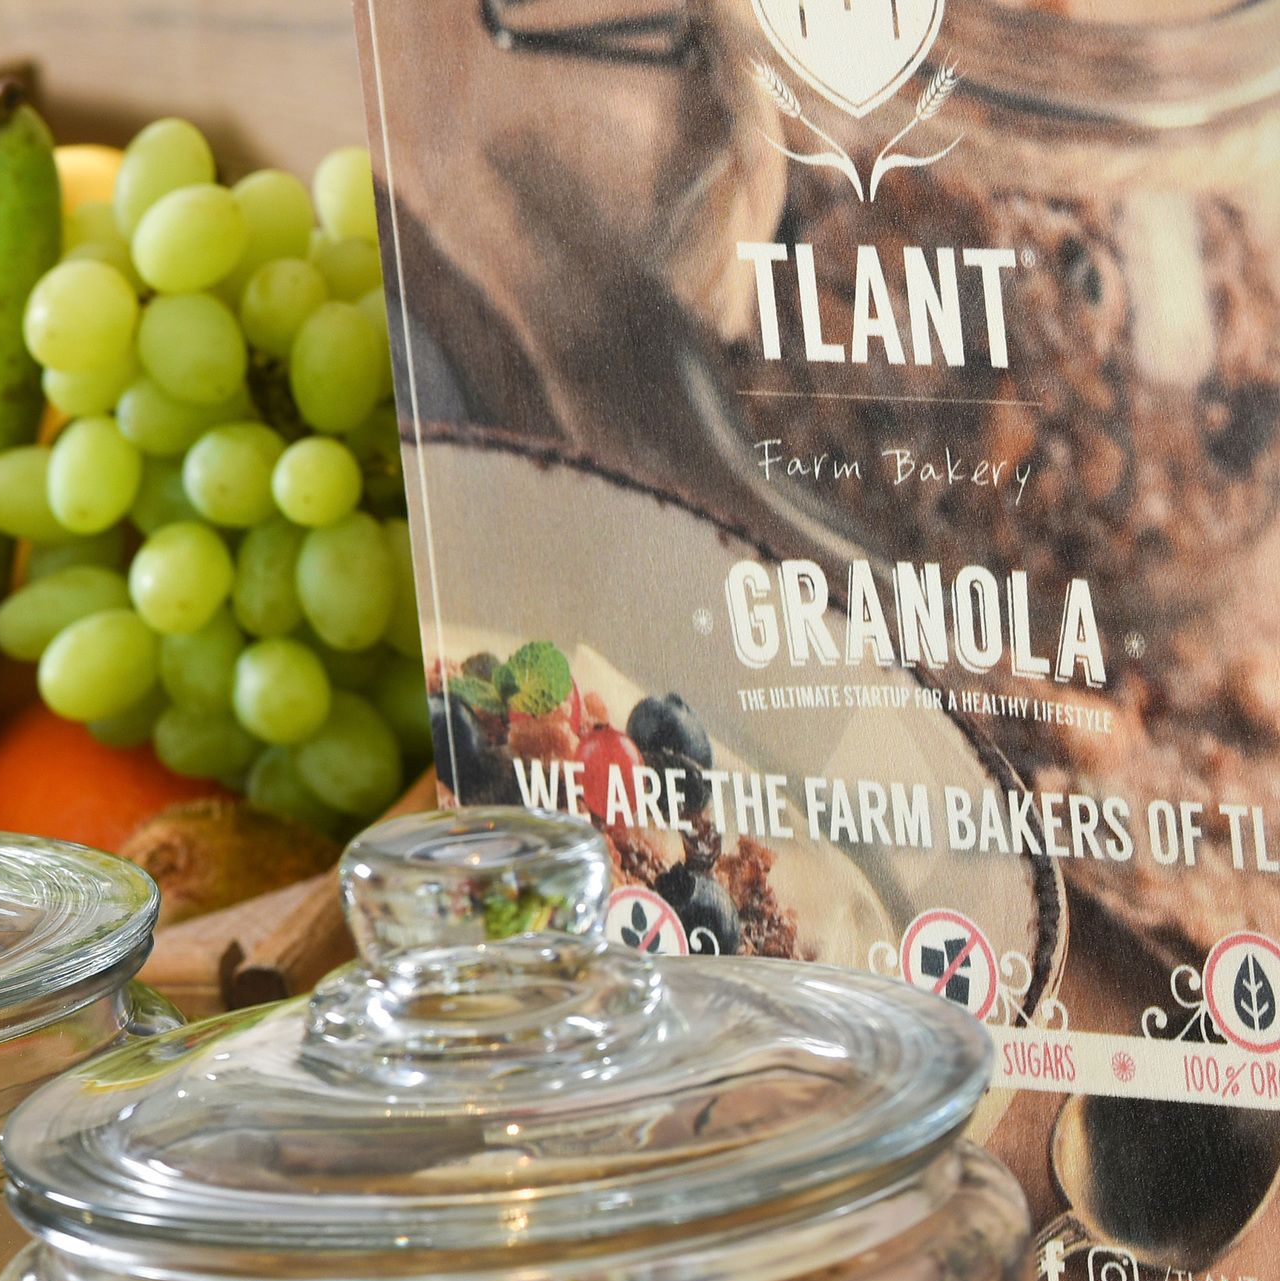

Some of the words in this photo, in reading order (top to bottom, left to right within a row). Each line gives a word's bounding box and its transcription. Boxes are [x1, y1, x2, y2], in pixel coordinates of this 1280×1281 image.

[754, 438, 862, 480] Farm
[881, 447, 1032, 506] Bakery
[724, 559, 1108, 686] GRANOLA
[738, 689, 767, 712] THE
[769, 686, 839, 709] ULTIMATE
[843, 686, 910, 708] STARTUP
[914, 689, 942, 710] FOR
[947, 691, 958, 711] A
[962, 691, 1029, 719] HEALTHY
[1033, 700, 1113, 733] LIFESTYLE
[513, 758, 590, 819] WE
[605, 764, 692, 831] ARE
[702, 770, 793, 840] THE
[804, 776, 933, 849] FARM
[944, 786, 1134, 862] BAKERS
[1147, 800, 1203, 867] OF
[1003, 1041, 1077, 1083] SUGARS
[1183, 1055, 1248, 1098] 100%
[1250, 1060, 1280, 1101] OR
